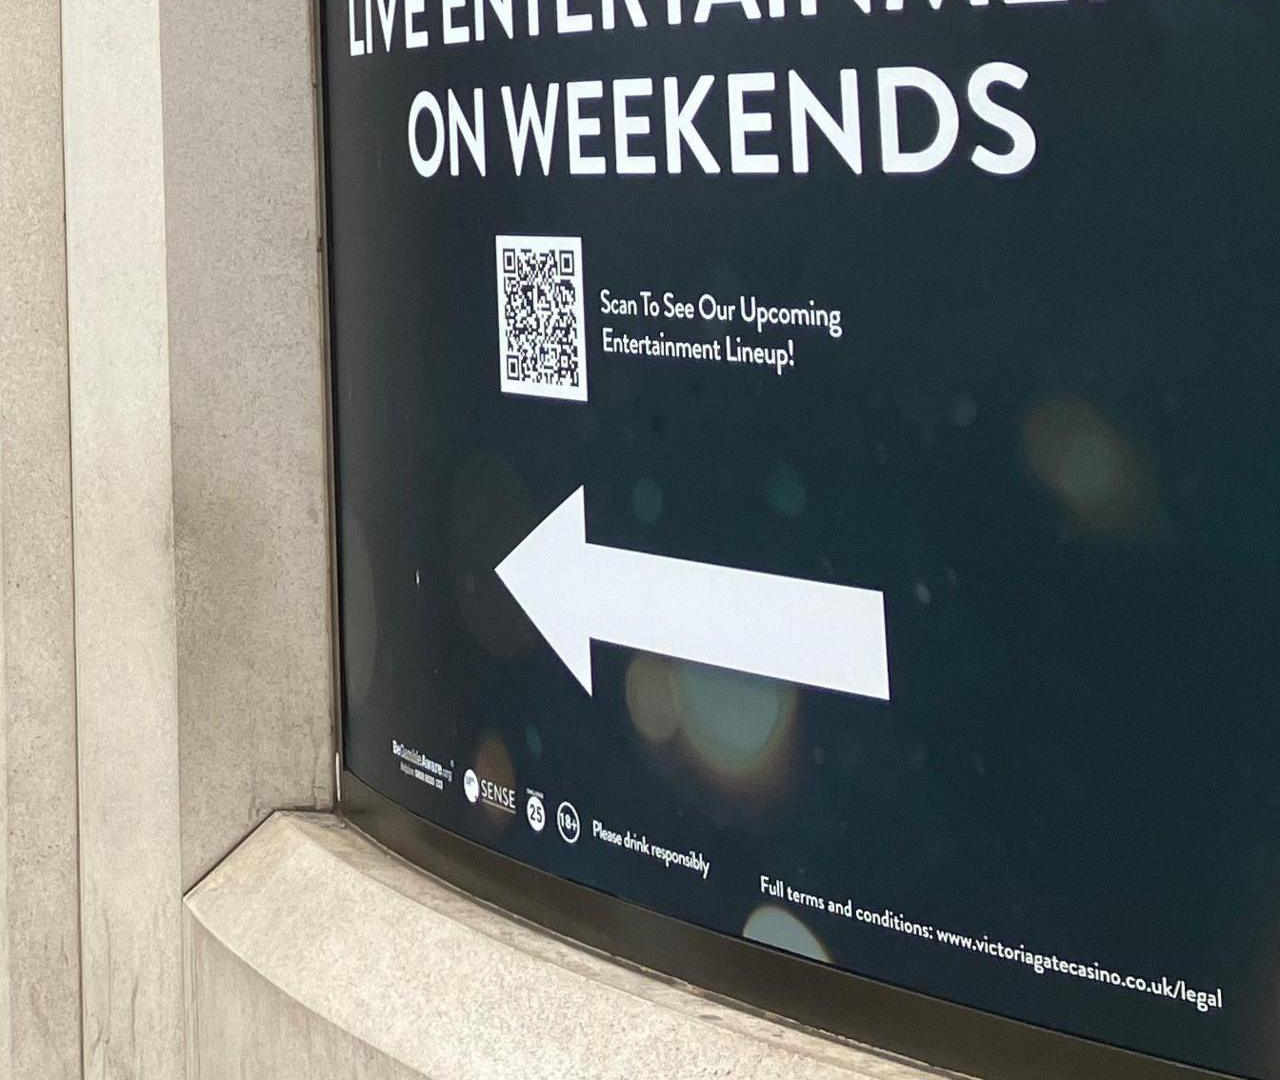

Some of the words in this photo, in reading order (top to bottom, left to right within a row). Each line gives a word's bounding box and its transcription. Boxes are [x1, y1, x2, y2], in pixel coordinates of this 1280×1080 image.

[408, 86, 486, 178] ON
[502, 61, 1037, 178] WEEKENDS
[600, 289, 637, 317] Scan
[640, 291, 660, 318] To
[663, 293, 694, 320] See
[698, 293, 736, 322] Our
[740, 296, 842, 338] Upcoming
[602, 328, 721, 362] Entertainment
[726, 335, 796, 375] Lineup!
[481, 779, 516, 809] SENSE
[530, 804, 542, 824] 25
[560, 812, 578, 832] 18+
[593, 820, 622, 846] Please
[624, 831, 650, 855] drink
[651, 844, 710, 880] responsibly
[760, 875, 784, 898] Full
[787, 886, 825, 910] terms
[827, 899, 852, 918] and
[855, 907, 934, 940] conditions:
[937, 927, 1223, 1012] www.victoriagatecasino.co.uk/legal
